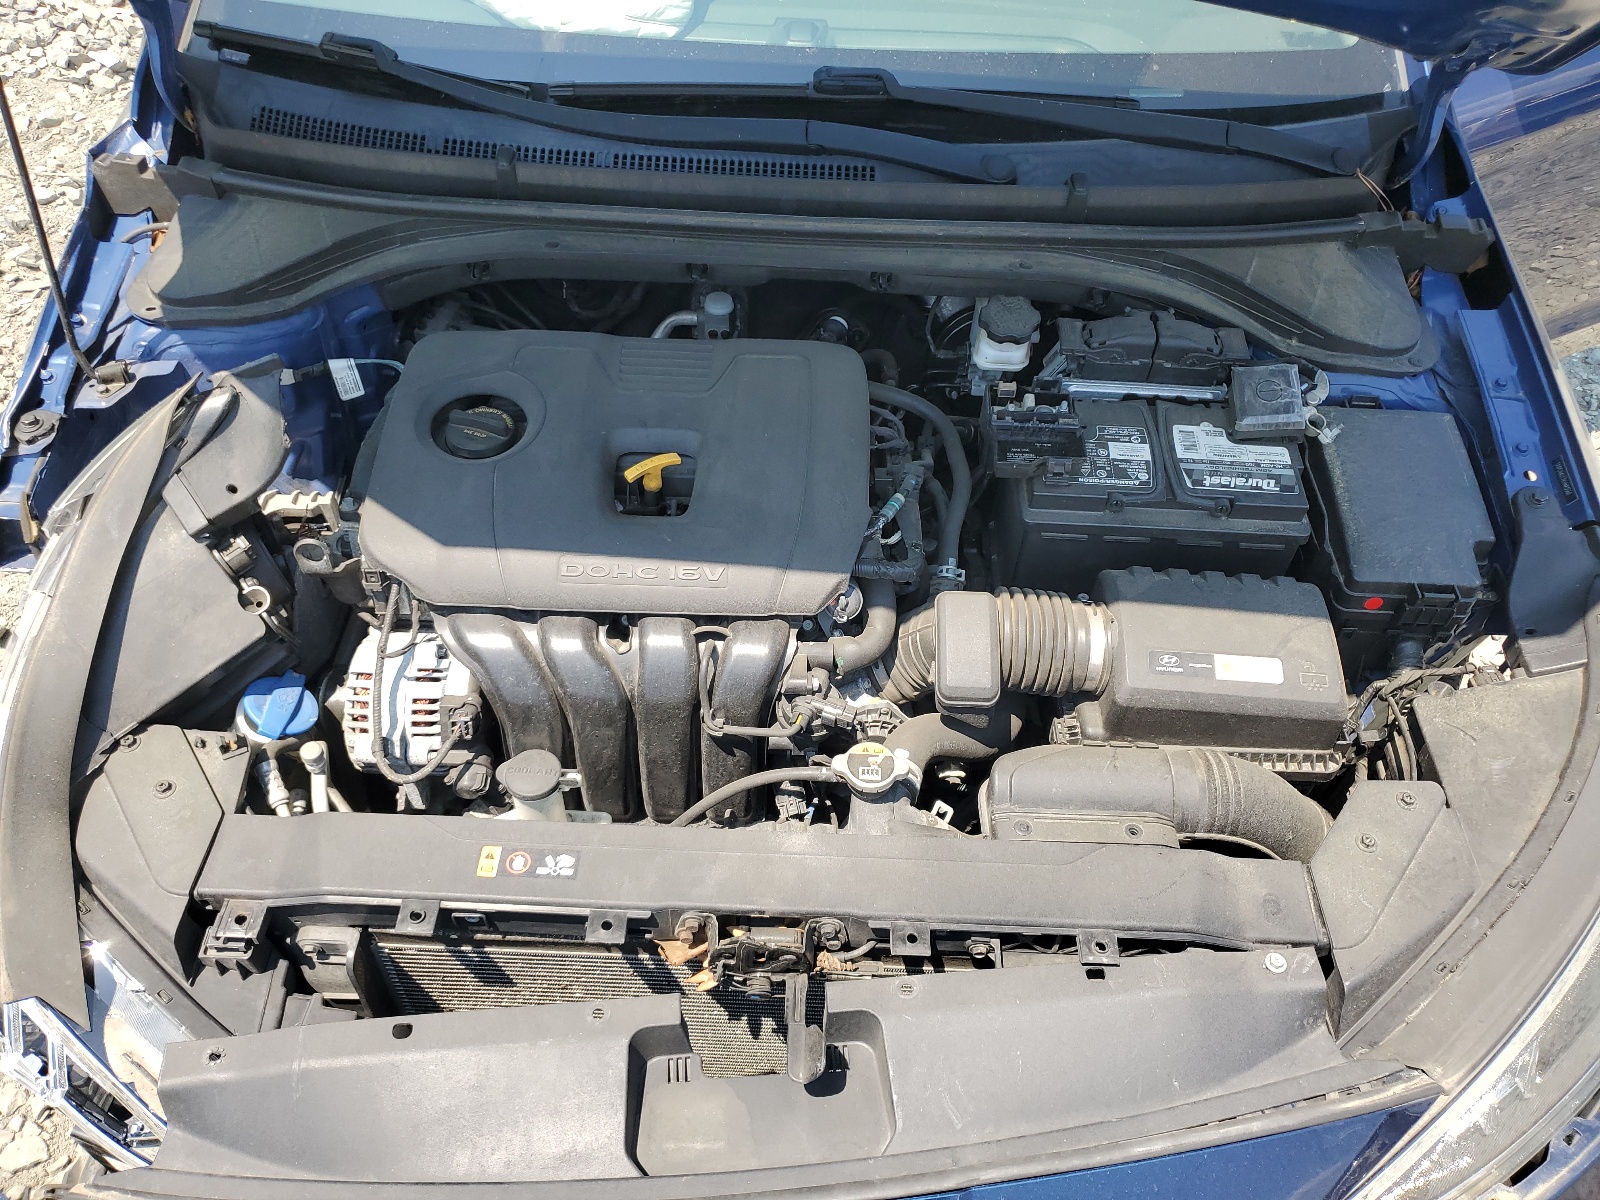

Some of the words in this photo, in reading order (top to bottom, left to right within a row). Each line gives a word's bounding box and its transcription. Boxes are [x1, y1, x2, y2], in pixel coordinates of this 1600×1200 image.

[1203, 470, 1249, 478] PLATNUM
[1203, 475, 1281, 491] Duralast
[560, 563, 660, 580] DOHC
[668, 565, 727, 582] 16V
[506, 766, 559, 777] COOLANT
